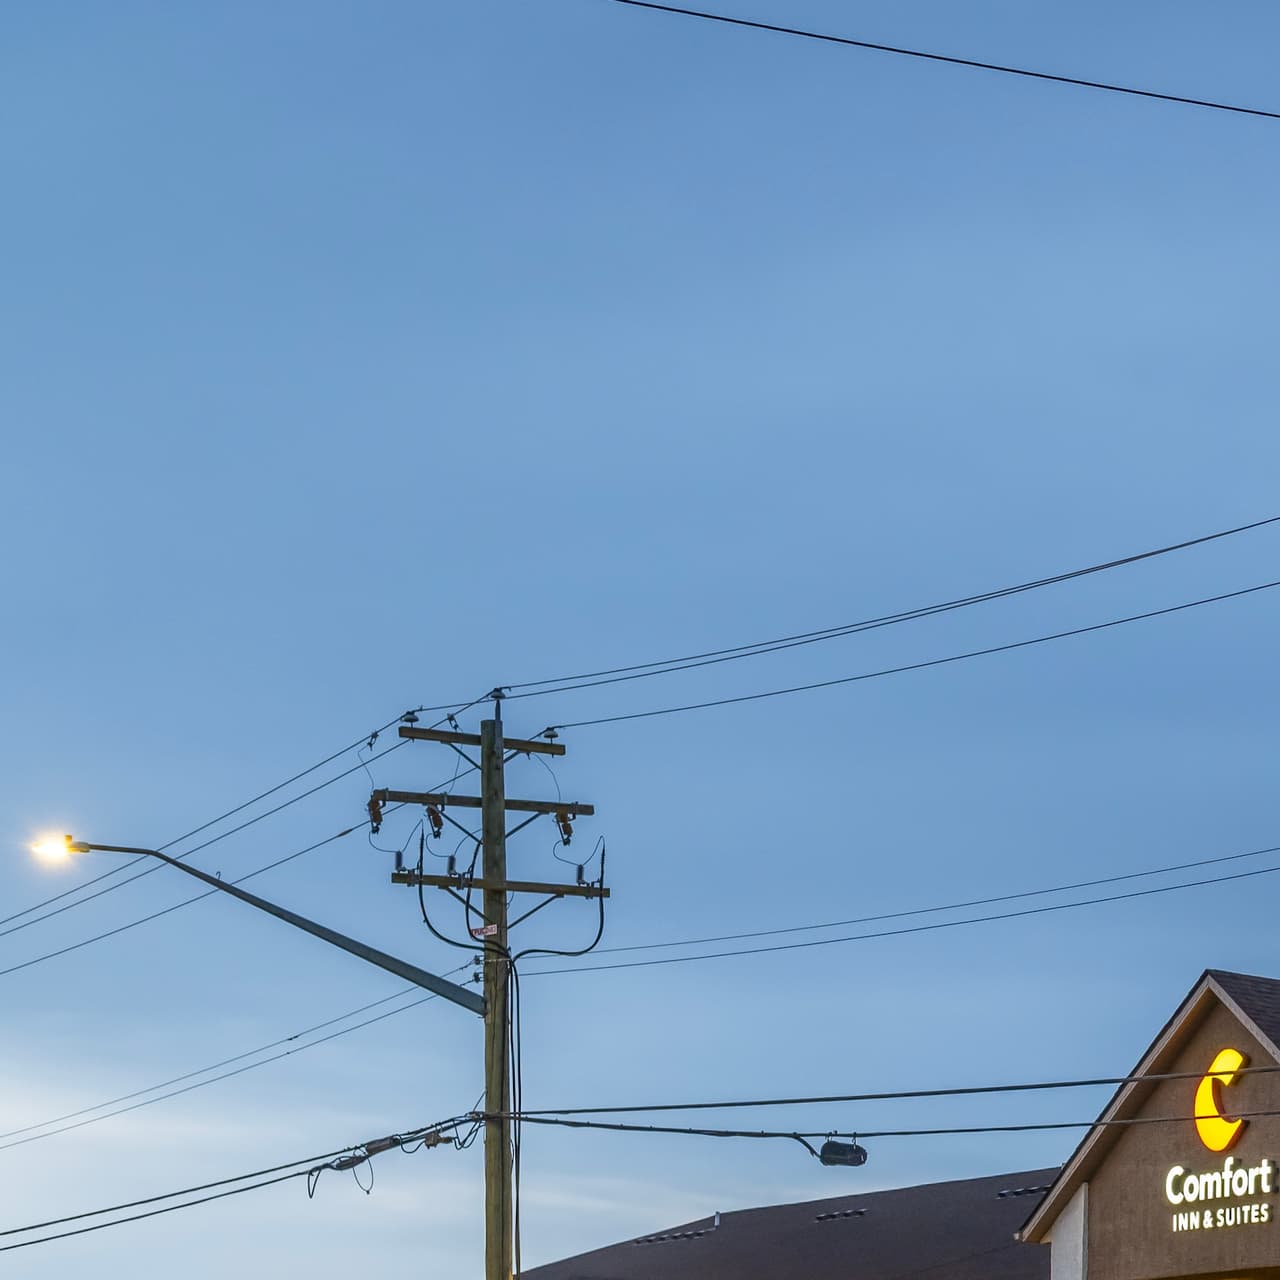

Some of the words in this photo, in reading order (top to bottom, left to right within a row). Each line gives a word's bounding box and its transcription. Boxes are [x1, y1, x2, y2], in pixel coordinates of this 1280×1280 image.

[1165, 1156, 1272, 1204] Comfort
[1172, 1210, 1200, 1232] INN
[1203, 1210, 1214, 1229] &
[1216, 1203, 1269, 1227] SUITES
